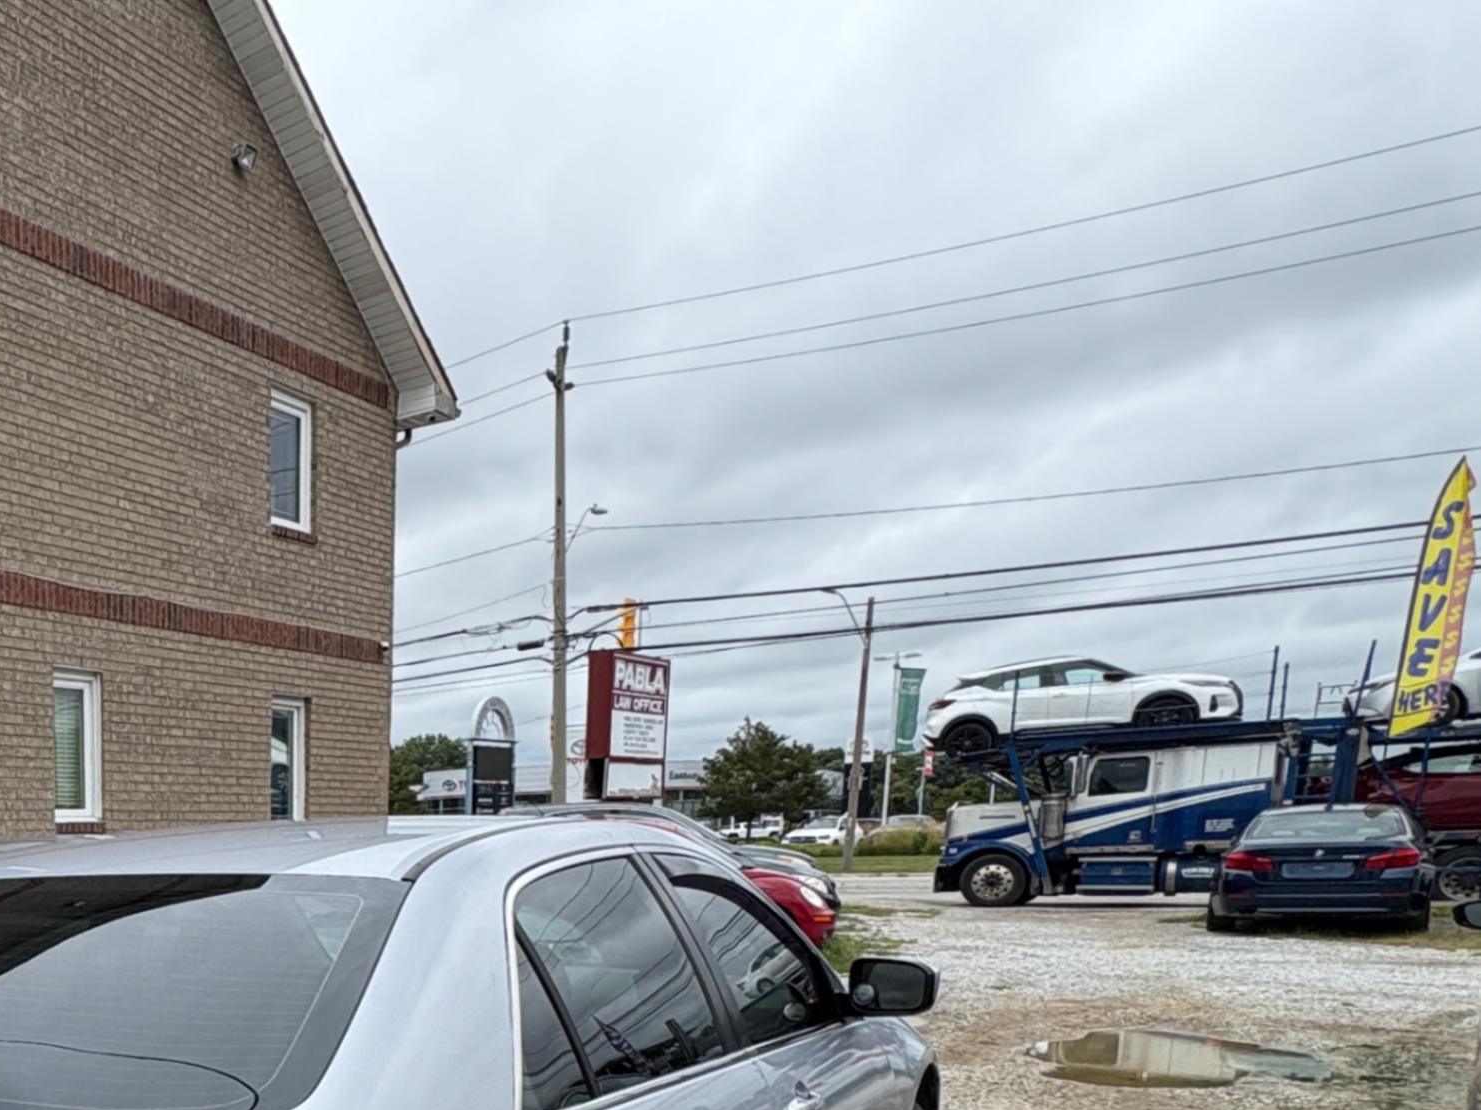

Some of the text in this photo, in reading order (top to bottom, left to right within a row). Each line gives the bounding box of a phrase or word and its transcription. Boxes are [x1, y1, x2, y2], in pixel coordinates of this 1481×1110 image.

[1407, 501, 1465, 678] SAVE
[614, 657, 665, 694] PABLA
[614, 694, 663, 714] LAW OFFICE
